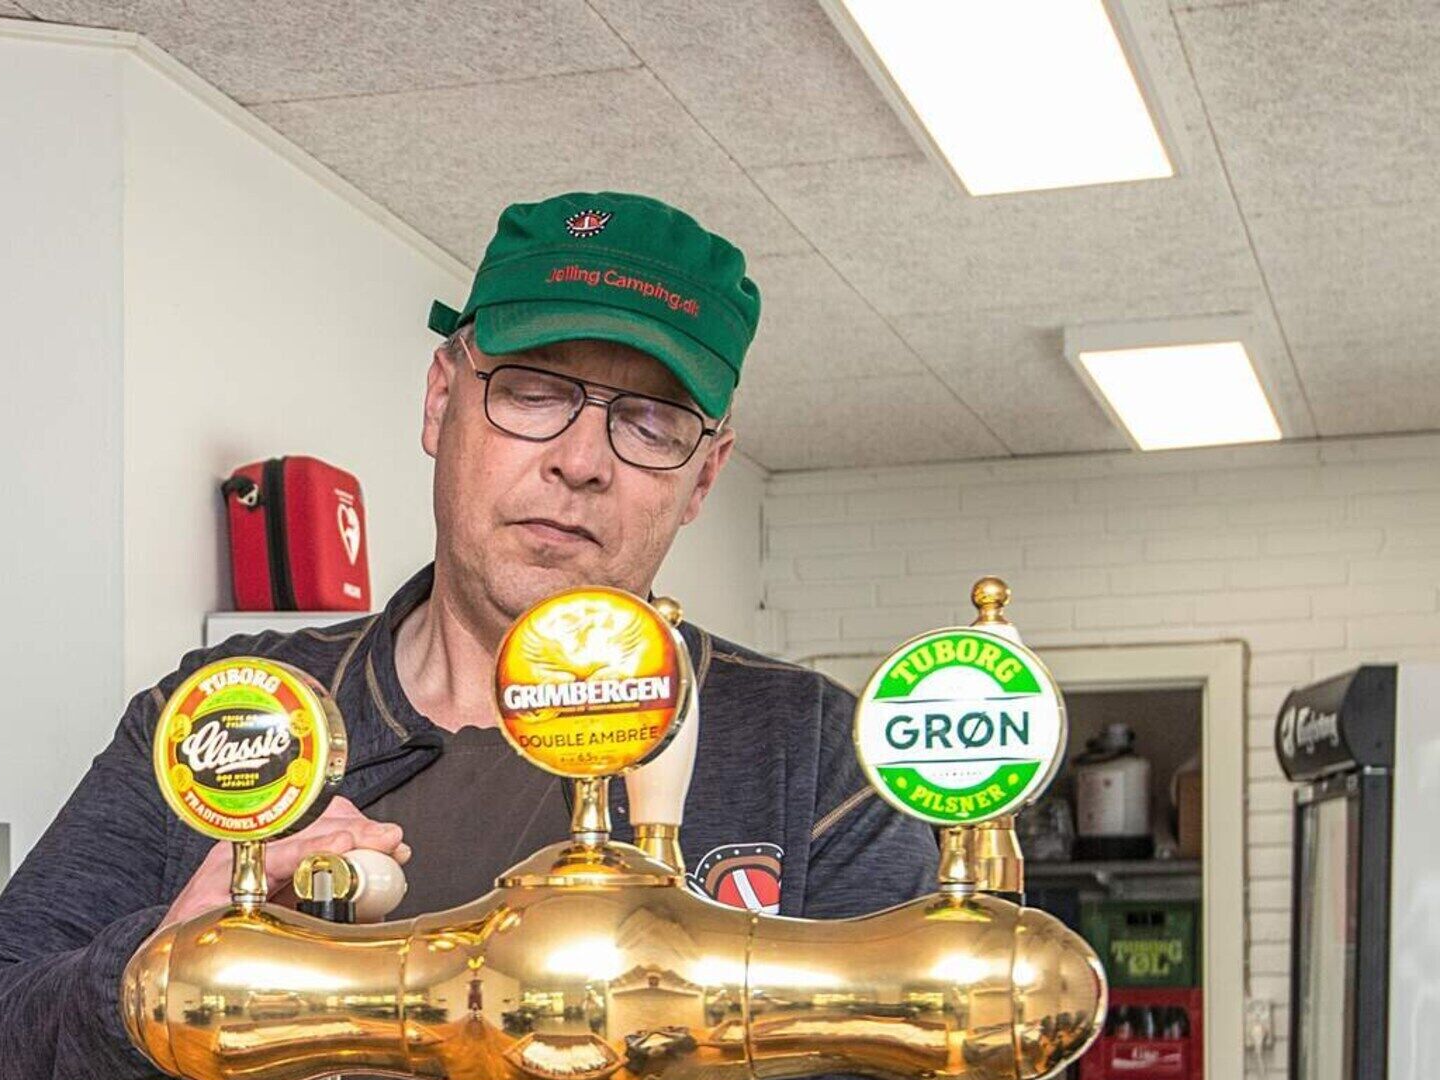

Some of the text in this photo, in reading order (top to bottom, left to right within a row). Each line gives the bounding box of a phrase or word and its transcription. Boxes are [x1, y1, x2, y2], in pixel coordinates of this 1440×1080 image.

[890, 638, 1023, 685] TUBORG
[198, 667, 282, 695] TUBORG
[504, 676, 670, 711] GRIMBERGEN
[181, 720, 291, 772] Classic
[518, 723, 660, 749] DOUBLE AMBRÉE
[885, 710, 1030, 751] GRØN
[182, 788, 301, 830] TRADITIONEL PILSNER
[909, 783, 1007, 814] PILSNER
